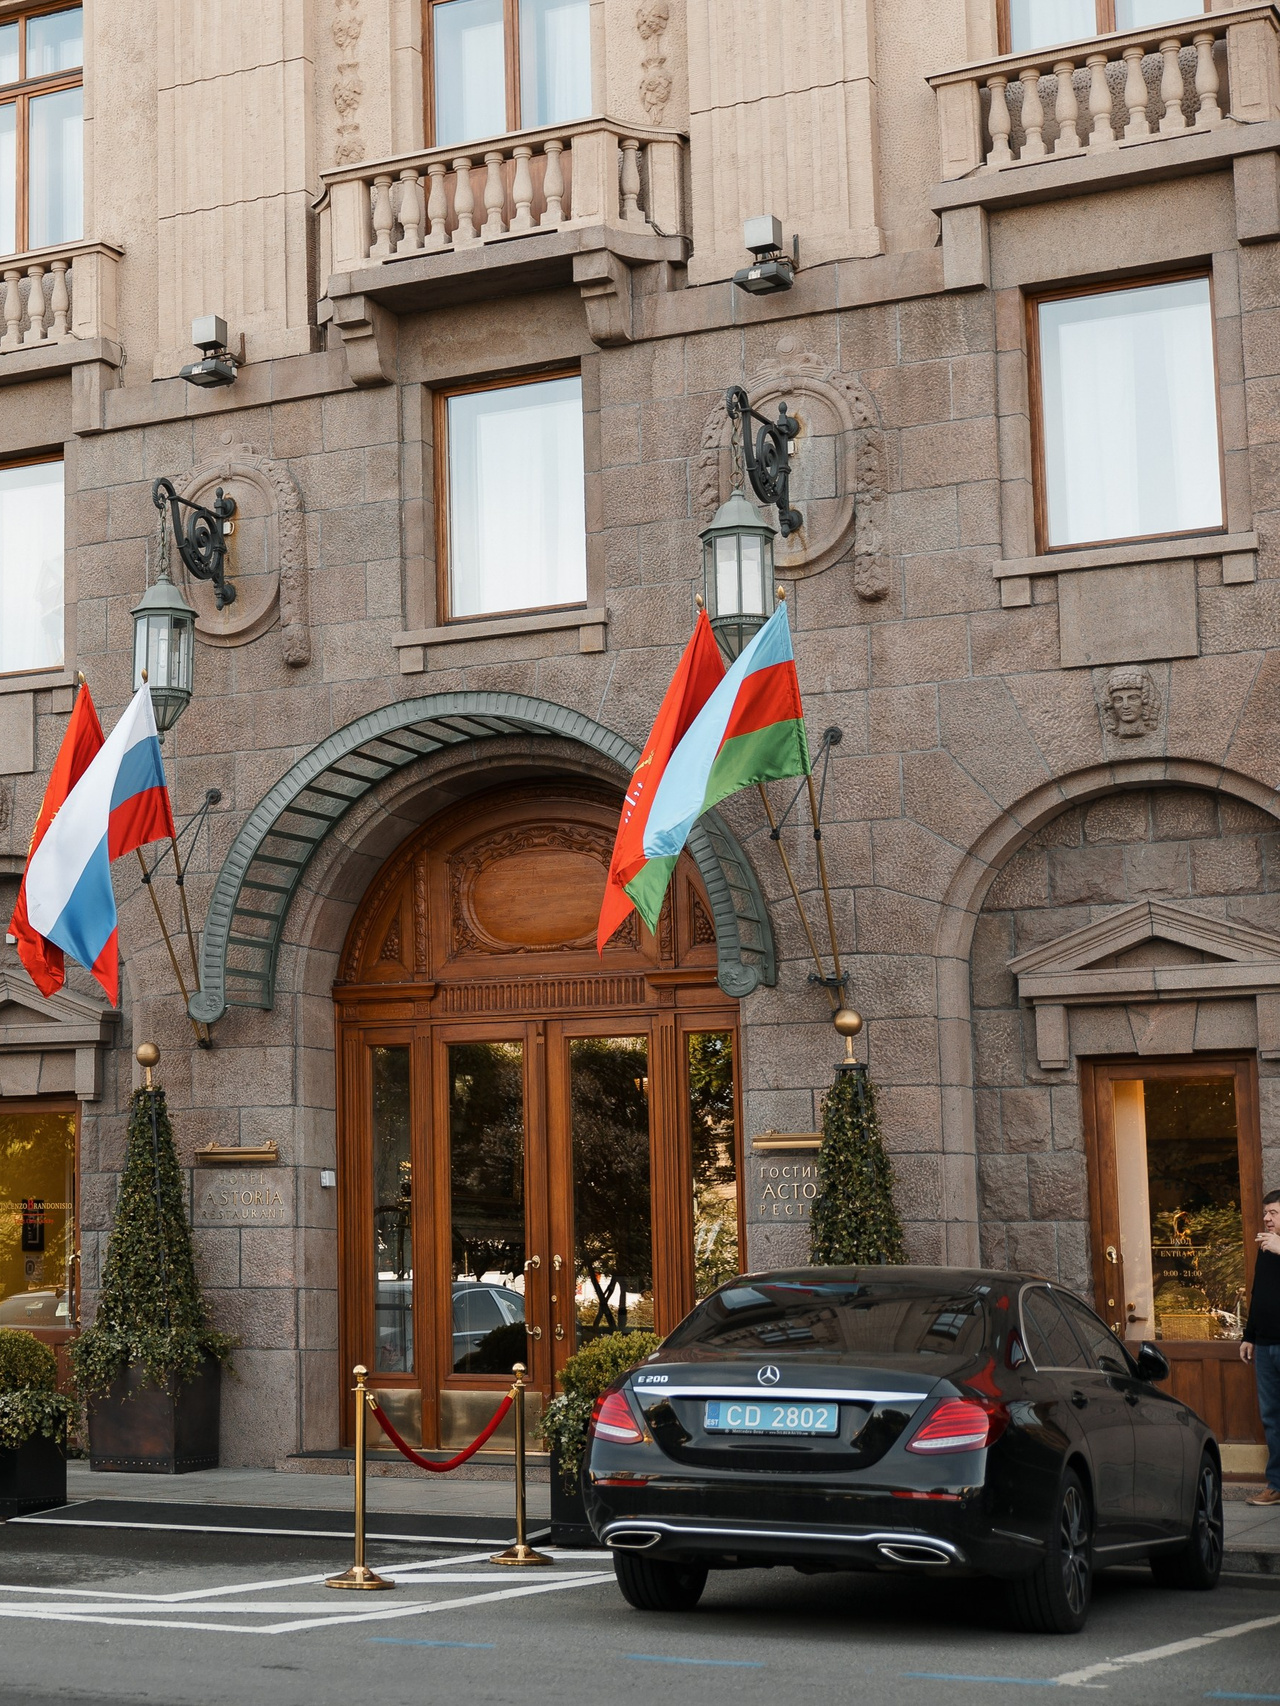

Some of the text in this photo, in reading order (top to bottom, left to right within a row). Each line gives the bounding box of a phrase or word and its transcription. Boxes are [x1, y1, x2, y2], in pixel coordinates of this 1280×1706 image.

[219, 1173, 266, 1185] HOTEL
[762, 1182, 818, 1199] АСТО
[27, 1198, 73, 1210] BRANDONISIO
[760, 1203, 805, 1215] РЕСТ
[201, 1208, 284, 1220] RESTAURANT
[637, 1375, 669, 1384] E 200
[706, 1418, 719, 1426] EST
[727, 1405, 828, 1429] CD 2802
